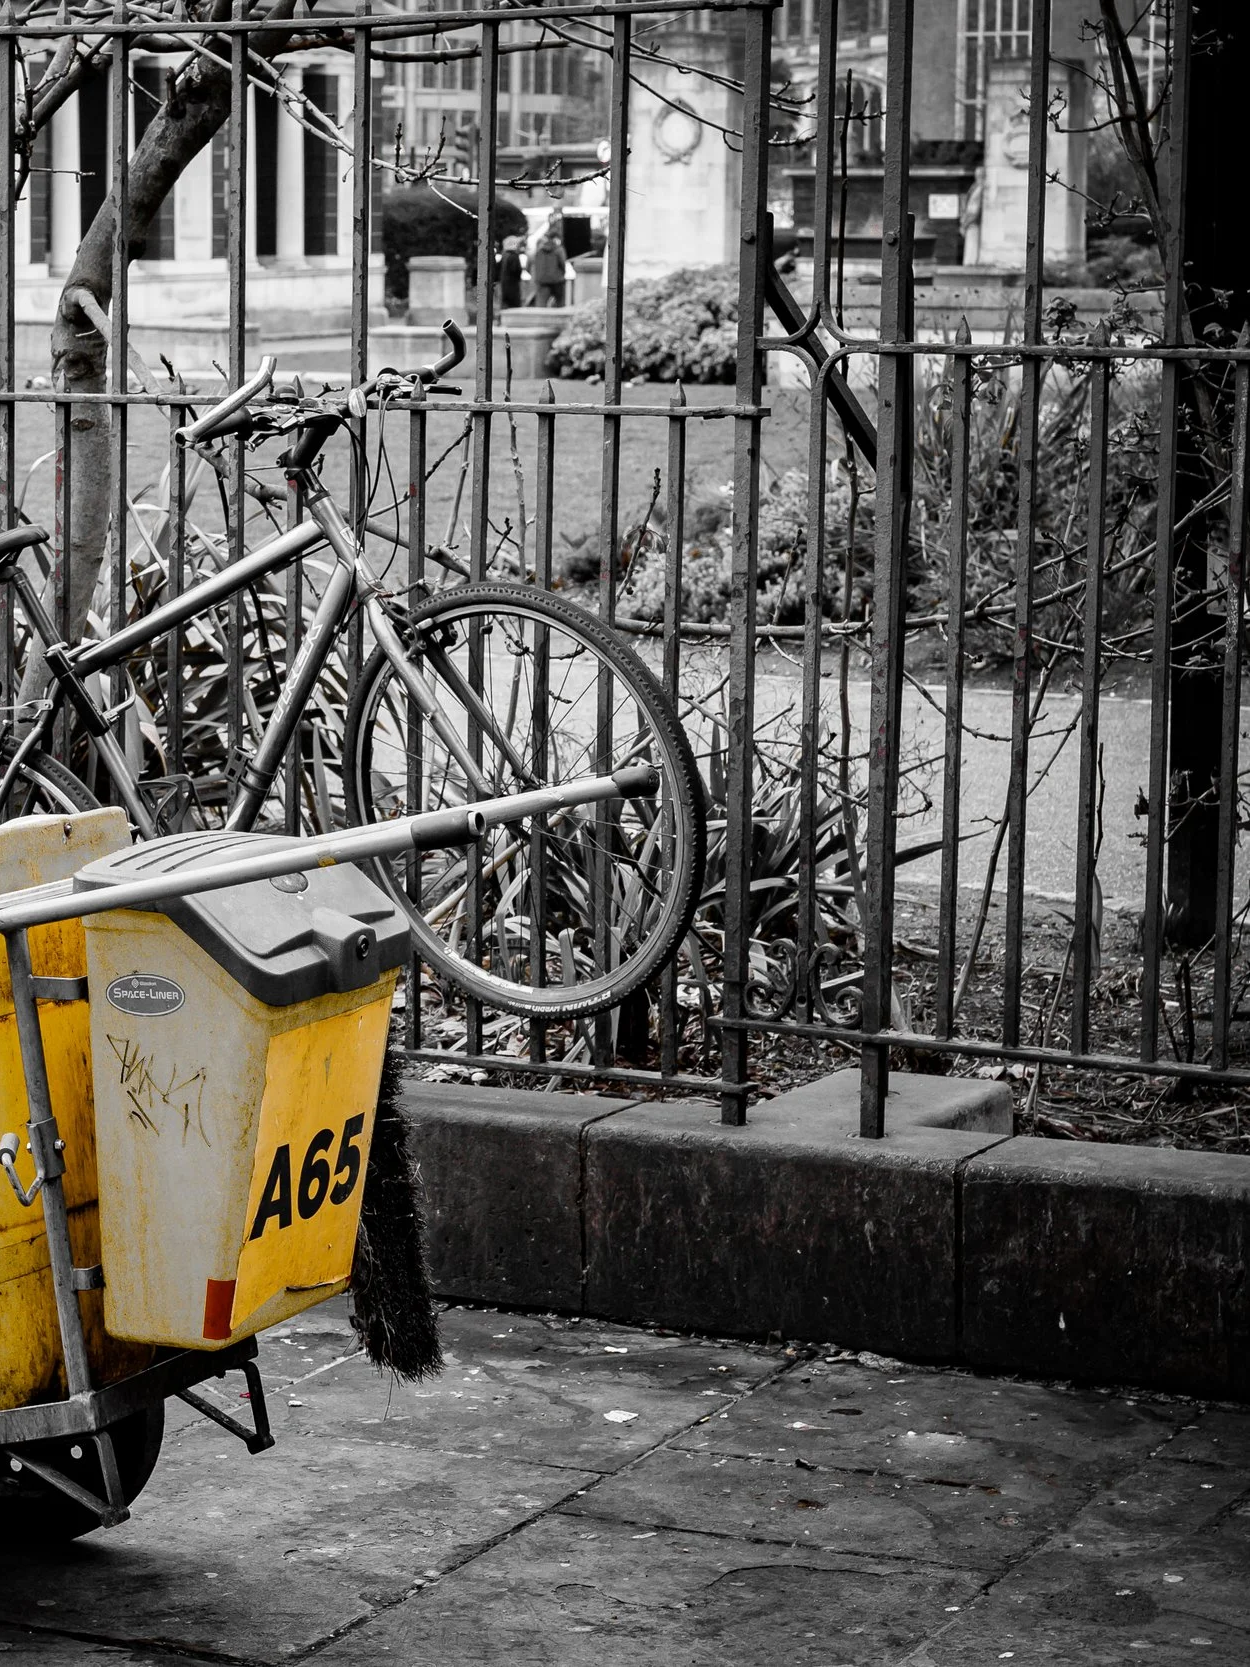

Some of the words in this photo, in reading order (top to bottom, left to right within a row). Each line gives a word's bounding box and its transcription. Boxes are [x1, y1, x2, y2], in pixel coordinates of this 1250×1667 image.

[269, 622, 324, 723] TREK
[113, 987, 180, 1000] SPACE-LINER
[249, 1111, 366, 1242] A65
